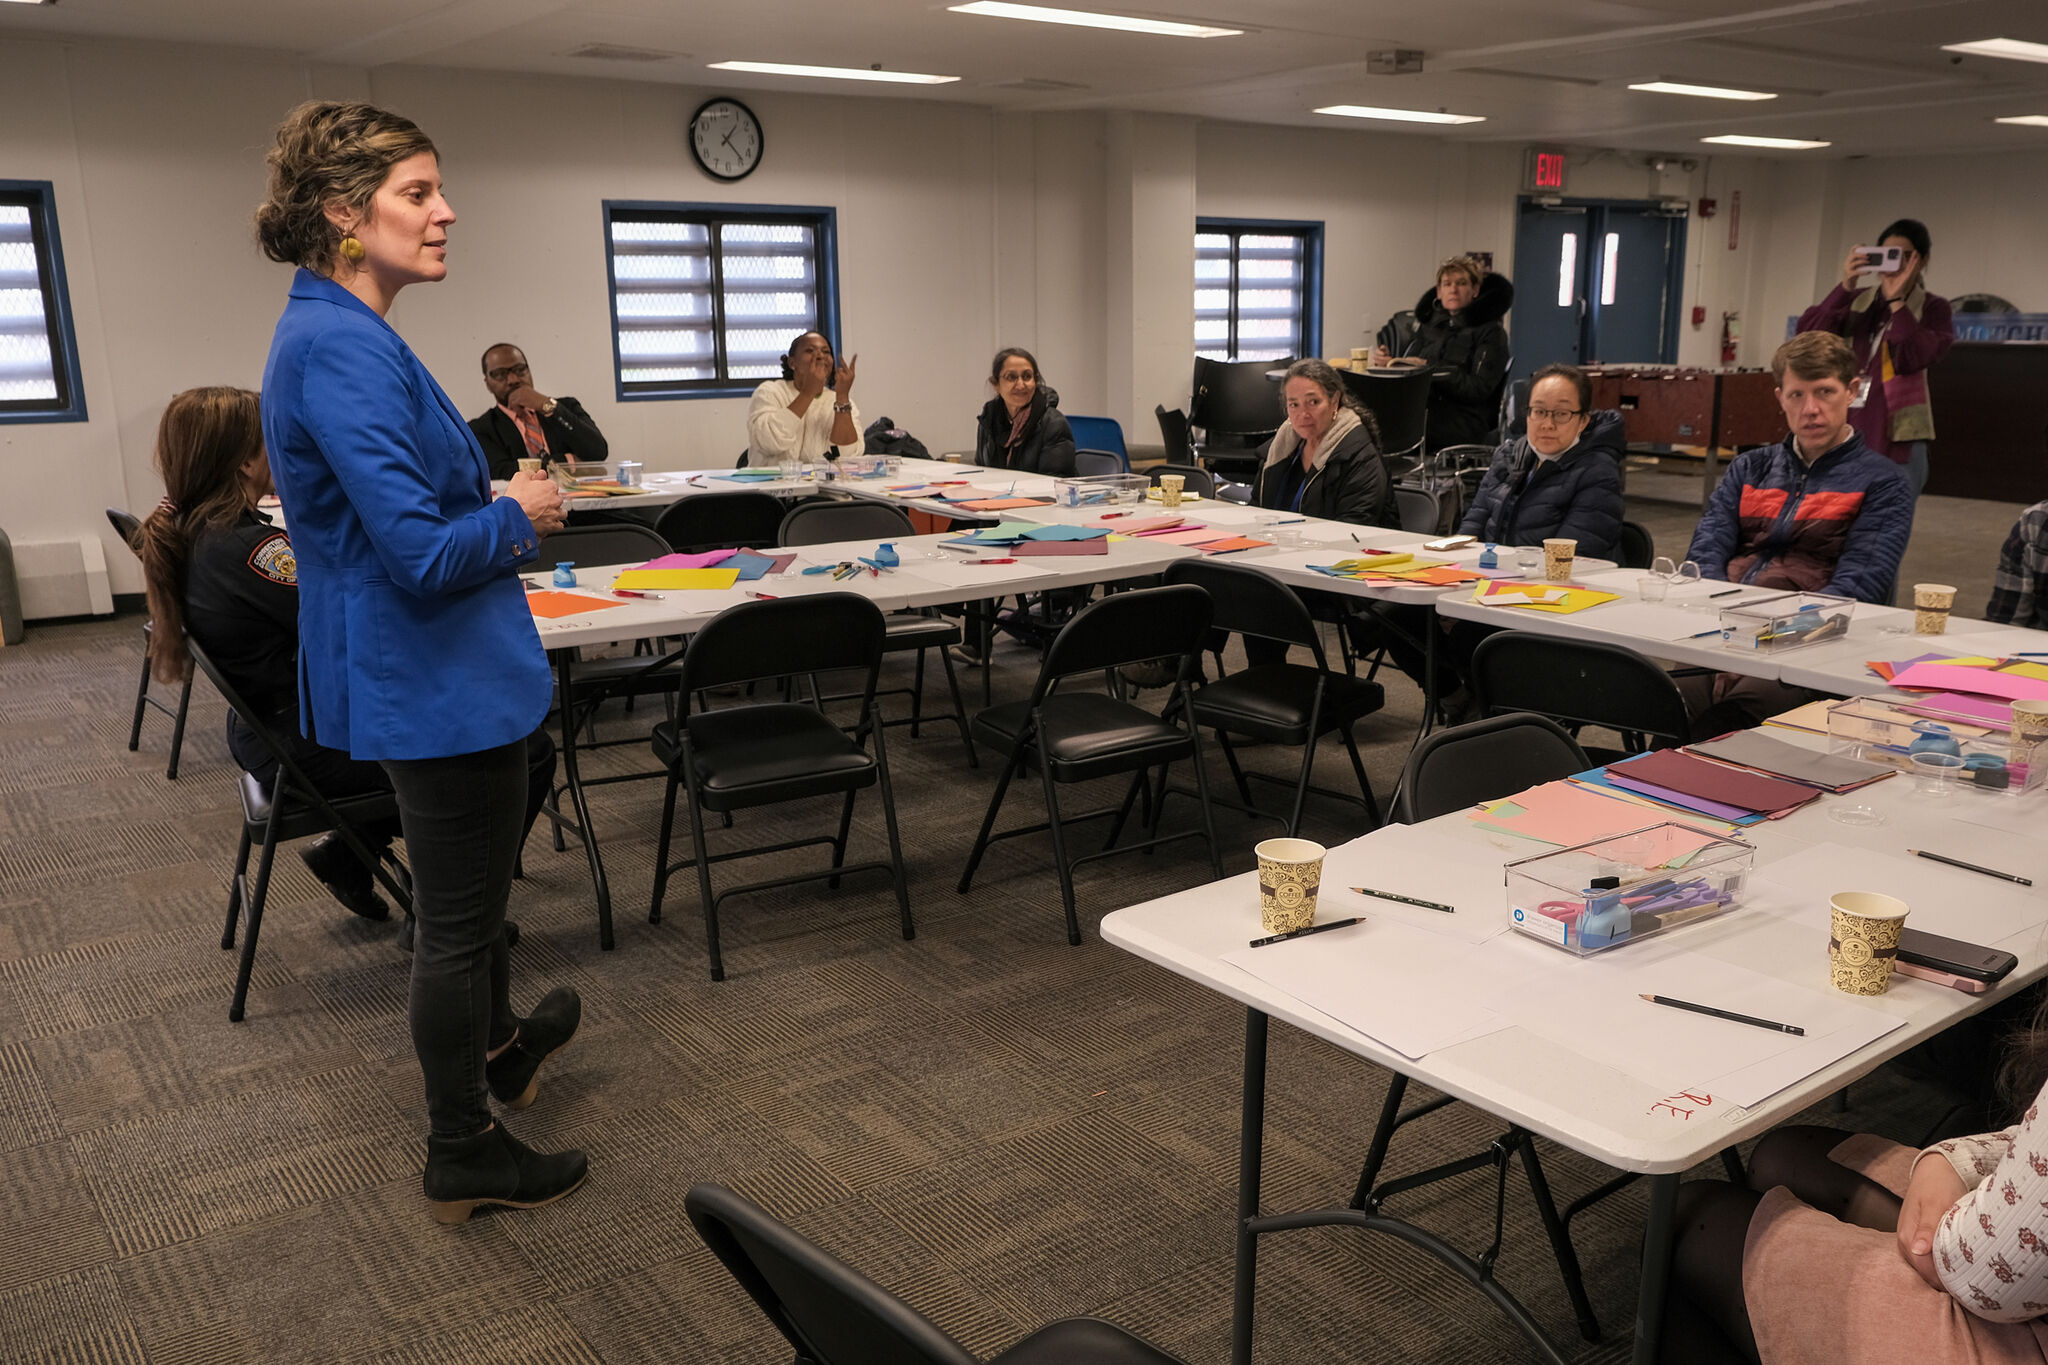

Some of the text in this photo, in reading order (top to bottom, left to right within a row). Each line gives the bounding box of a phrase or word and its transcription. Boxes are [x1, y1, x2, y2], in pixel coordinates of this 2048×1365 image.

[701, 121, 710, 131] 10
[743, 120, 749, 132] 2
[697, 134, 703, 144] 9
[748, 135, 755, 146] 3
[703, 148, 710, 159] 8
[745, 147, 752, 158] 4
[713, 158, 719, 169] 7
[725, 161, 732, 172] 6
[1536, 153, 1565, 187] EXIT
[268, 572, 285, 582] CITY
[1843, 946, 1869, 956] COFFEE
